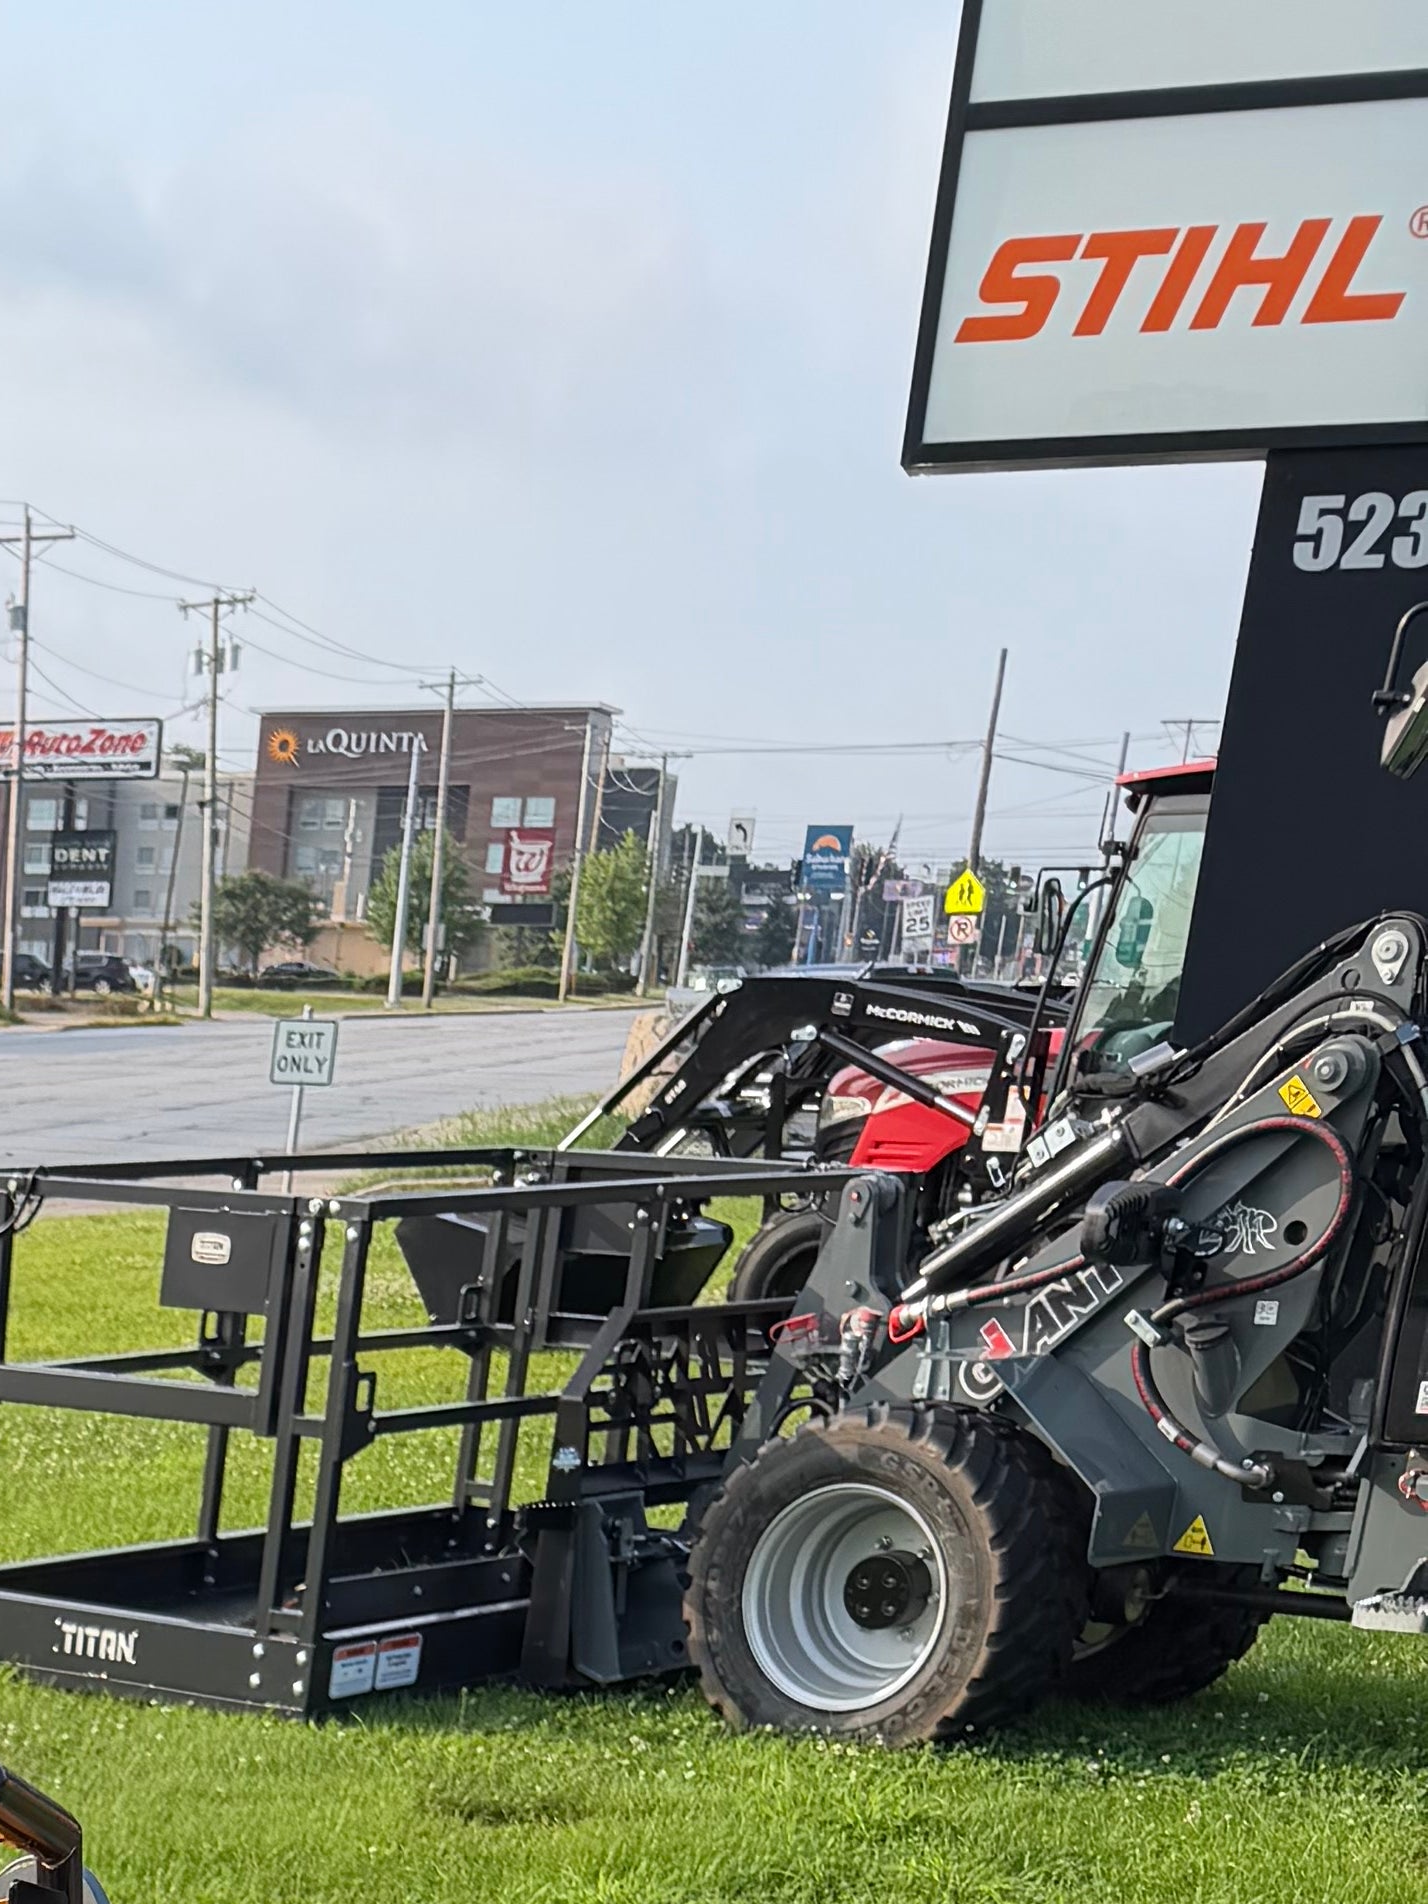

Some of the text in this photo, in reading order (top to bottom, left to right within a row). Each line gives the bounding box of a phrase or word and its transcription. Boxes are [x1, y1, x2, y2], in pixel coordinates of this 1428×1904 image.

[953, 214, 1407, 344] STIHL
[23, 728, 148, 757] AutoZone
[54, 848, 111, 863] DENT
[906, 915, 930, 933] 25
[865, 1003, 956, 1031] McCORMICK
[286, 1030, 325, 1049] EXIT
[277, 1055, 328, 1074] ONLY
[60, 1621, 136, 1665] TITAN
